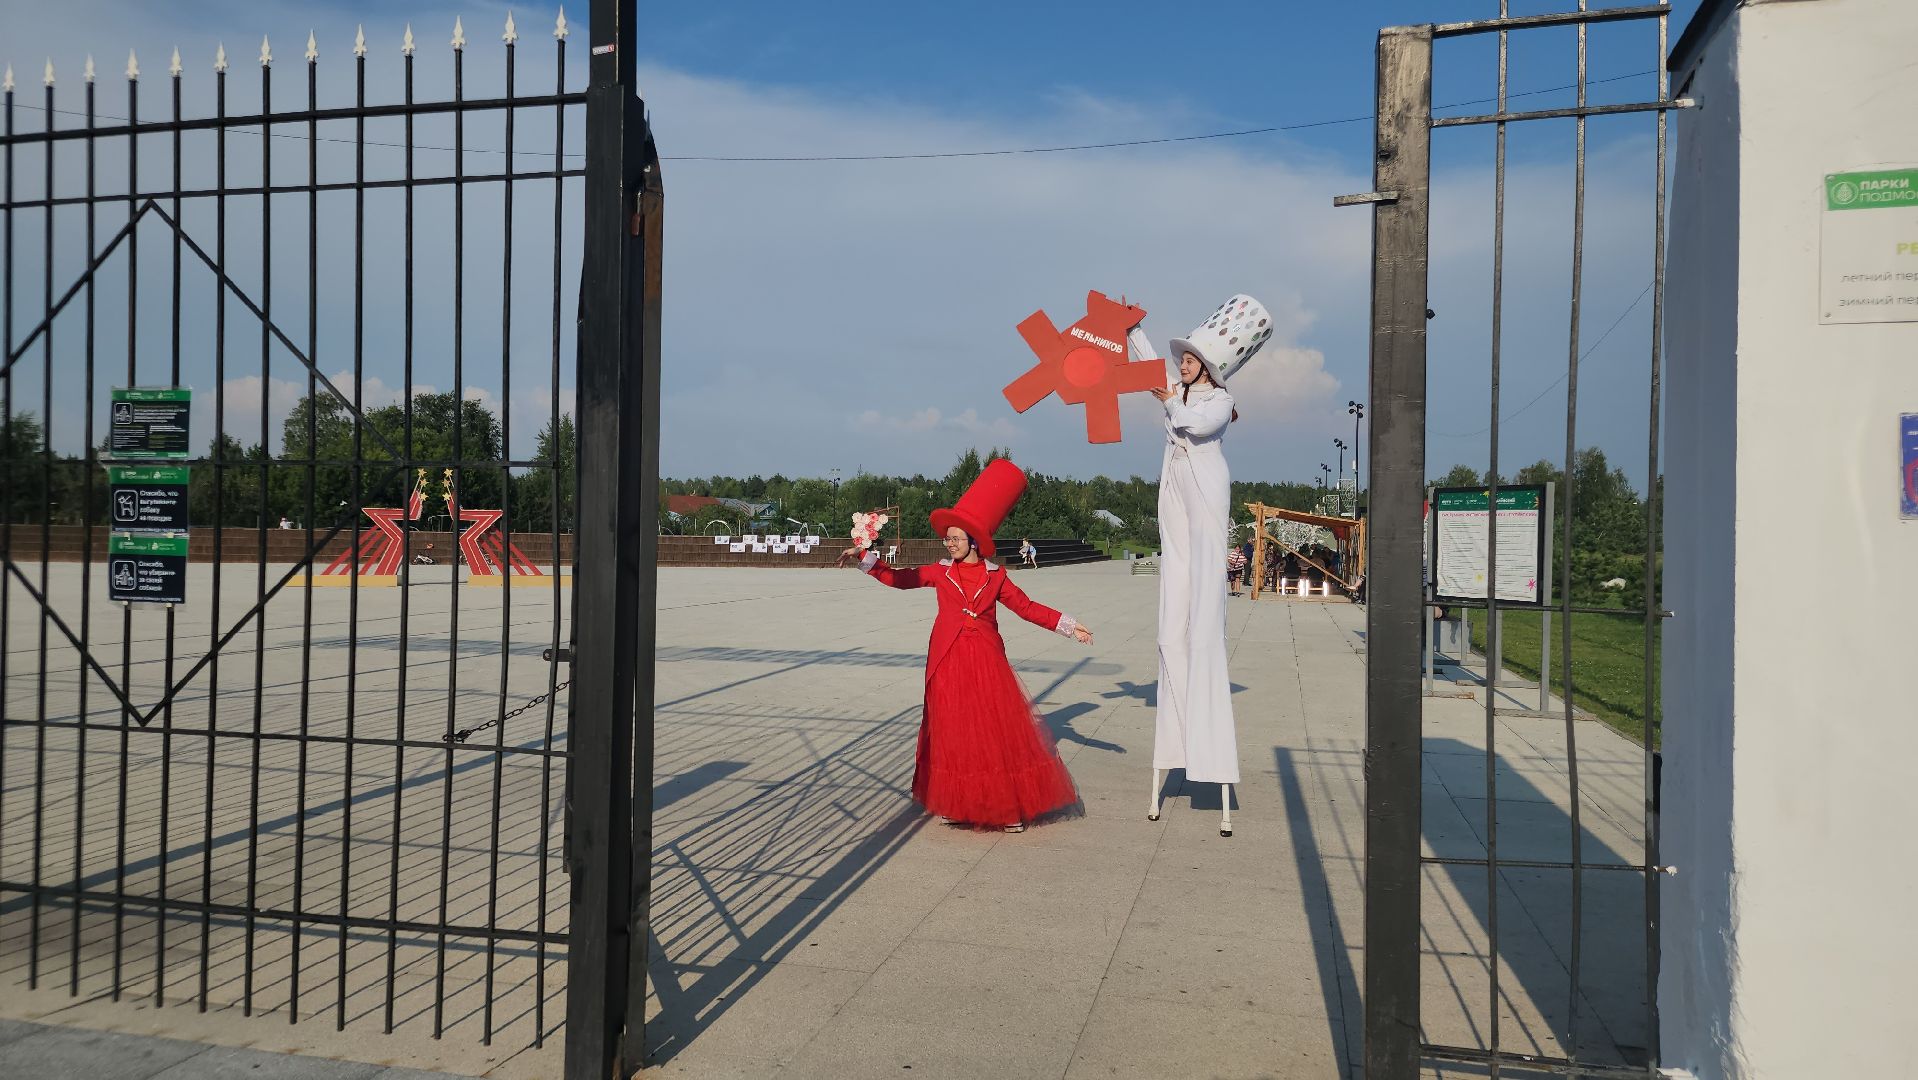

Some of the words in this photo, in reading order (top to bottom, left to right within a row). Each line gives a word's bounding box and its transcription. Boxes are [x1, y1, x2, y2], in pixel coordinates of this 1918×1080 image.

[1860, 178, 1909, 190] ПАРКИ
[1860, 190, 1918, 202] ПОДМО
[1840, 271, 1893, 282] летний
[1839, 295, 1894, 306] зимний
[1070, 327, 1123, 353] МЕЛЬНИКОВ
